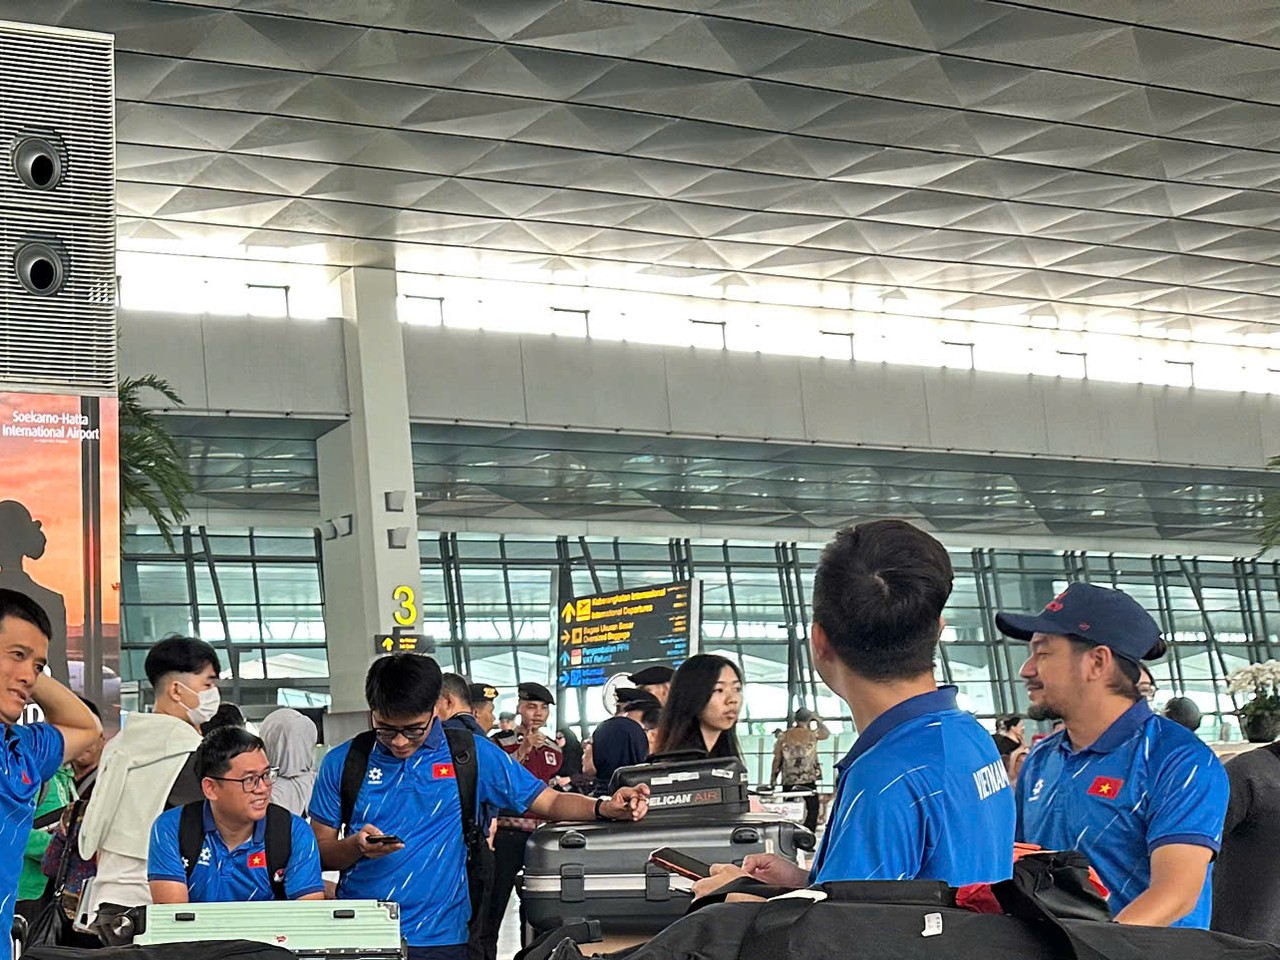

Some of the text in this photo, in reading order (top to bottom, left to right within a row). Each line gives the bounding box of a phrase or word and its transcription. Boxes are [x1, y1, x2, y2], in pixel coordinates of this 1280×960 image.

[12, 410, 89, 426] Soekarno-Hatta
[2, 424, 100, 441] International Airport
[393, 585, 418, 626] 3
[694, 791, 719, 802] AIR
